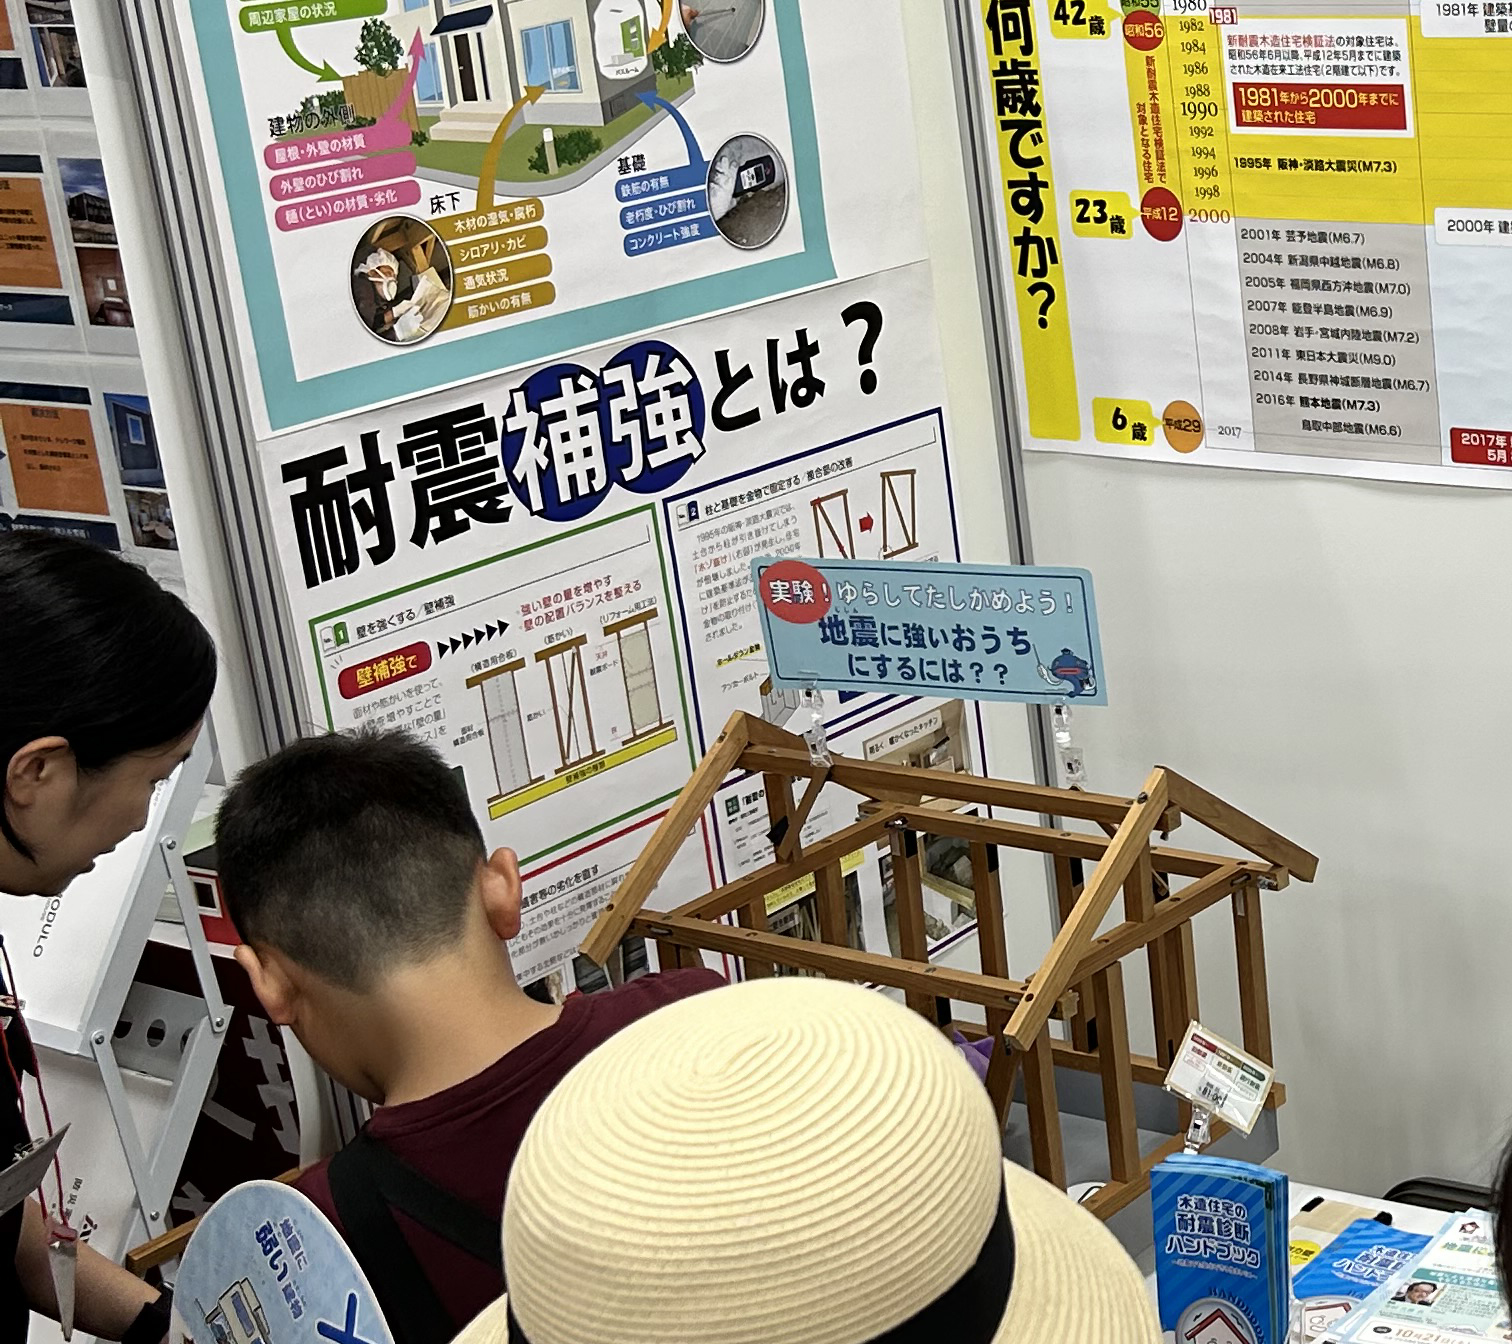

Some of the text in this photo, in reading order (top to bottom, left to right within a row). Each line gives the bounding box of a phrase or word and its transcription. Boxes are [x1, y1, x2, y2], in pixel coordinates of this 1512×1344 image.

[249, 2, 337, 26] 周辺家屋の状況
[1179, 19, 1204, 33] 1982
[1185, 85, 1210, 97] 1988
[1239, 87, 1399, 108] 1981年から2000年までに
[268, 104, 356, 137] 建物の外側
[1242, 110, 1316, 124] 建築された住宅
[618, 154, 647, 174] 基礎
[1191, 146, 1215, 159] 1994
[280, 167, 364, 195] 外壁のひび割れ
[621, 176, 670, 199] 鉄筋の有無
[429, 191, 461, 215] 床下
[1189, 209, 1231, 224] 2000
[629, 226, 700, 251] コンクリート強度
[1241, 228, 1281, 242] 2001年
[463, 268, 509, 290] 通気状況
[468, 292, 532, 319] 筋かいの有無
[1248, 300, 1287, 314] 2007年
[1254, 370, 1293, 384] 2014年
[281, 300, 885, 590] 耐震補強とは？
[819, 615, 1031, 655] 地震に強いおうち
[356, 654, 418, 687] 壁補強で
[33, 893, 62, 957] ODULO
[1177, 1194, 1247, 1221] 木造住宅の
[1175, 1212, 1251, 1244] 耐震診断
[1166, 1235, 1260, 1268] ハンドブック
